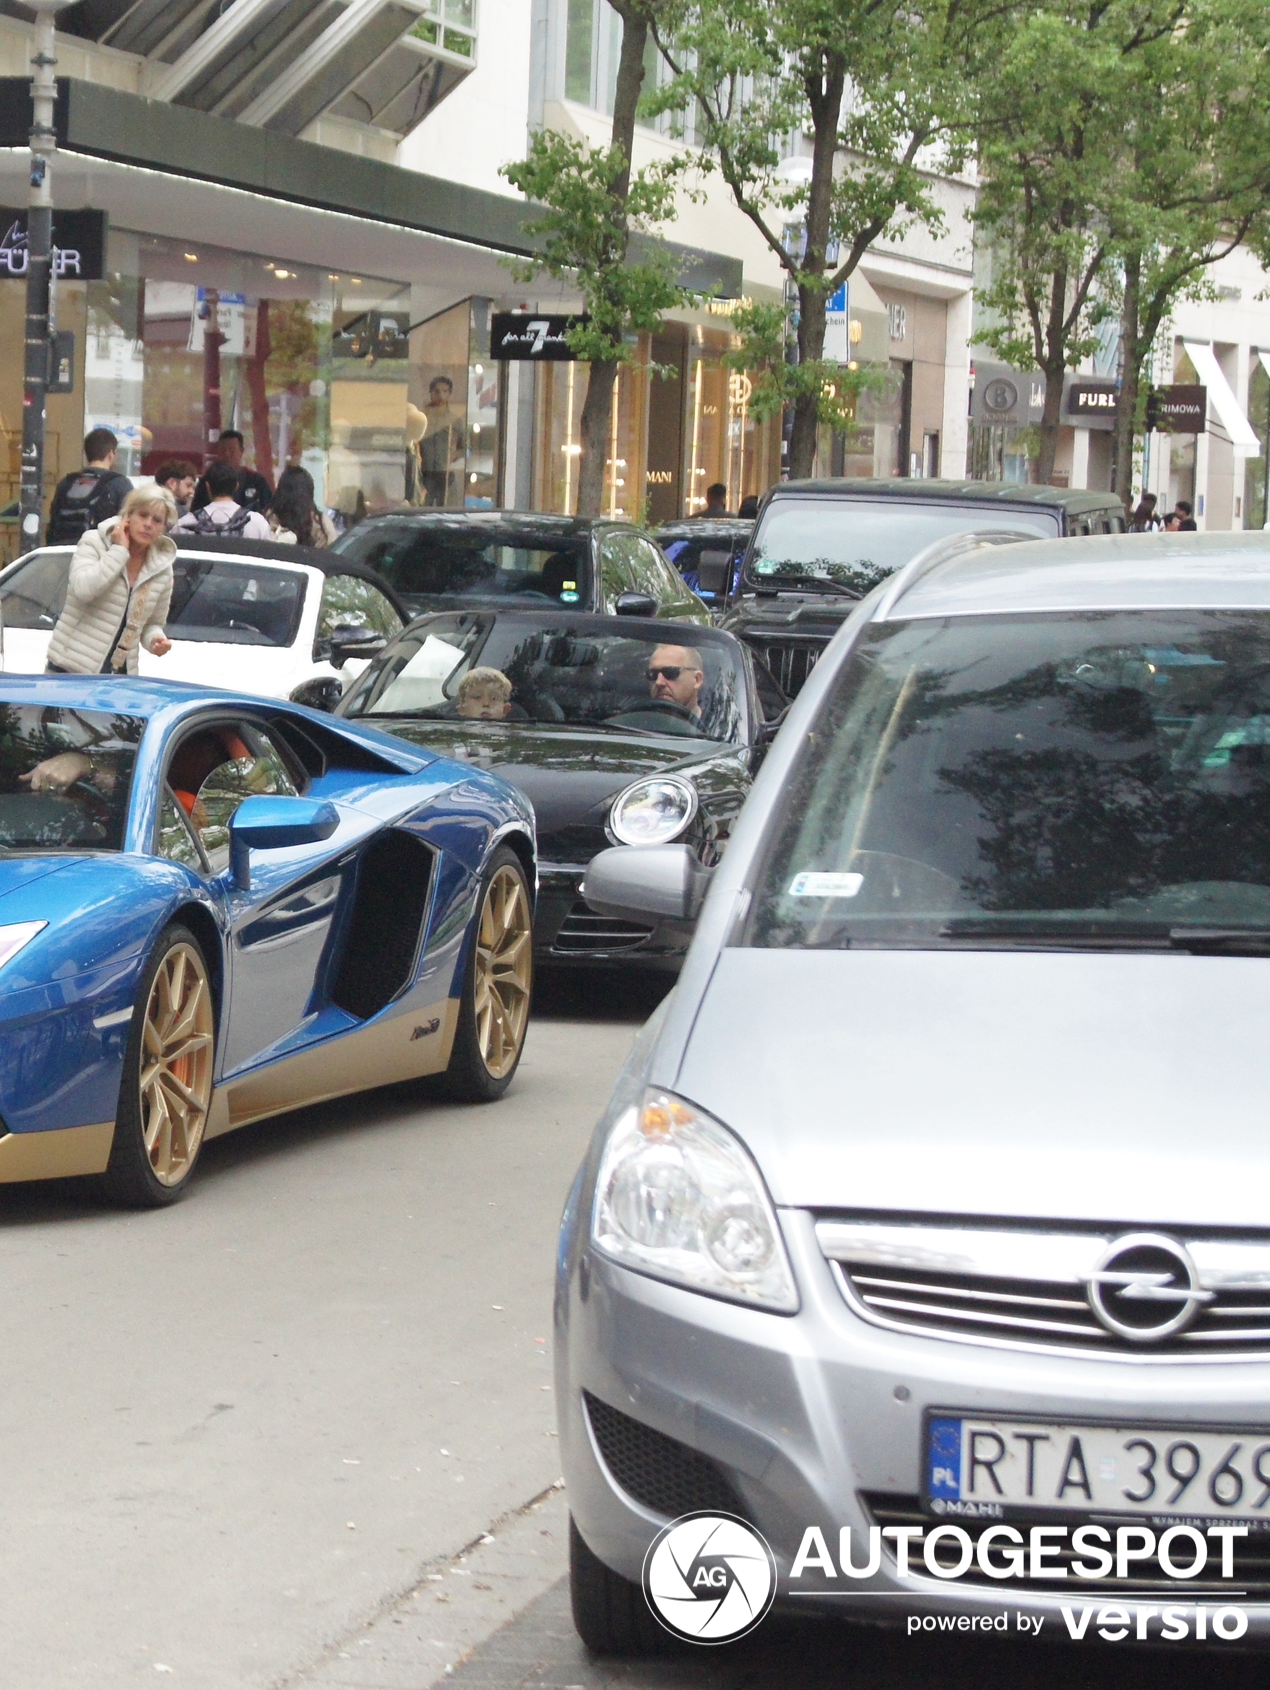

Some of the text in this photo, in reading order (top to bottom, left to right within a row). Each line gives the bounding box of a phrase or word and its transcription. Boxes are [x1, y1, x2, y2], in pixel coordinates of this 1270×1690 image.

[526, 321, 550, 353] 7
[1078, 393, 1117, 407] FURL
[1160, 403, 1201, 415] RIMOWA
[967, 1429, 1093, 1500] RTA
[932, 1466, 959, 1489] PL
